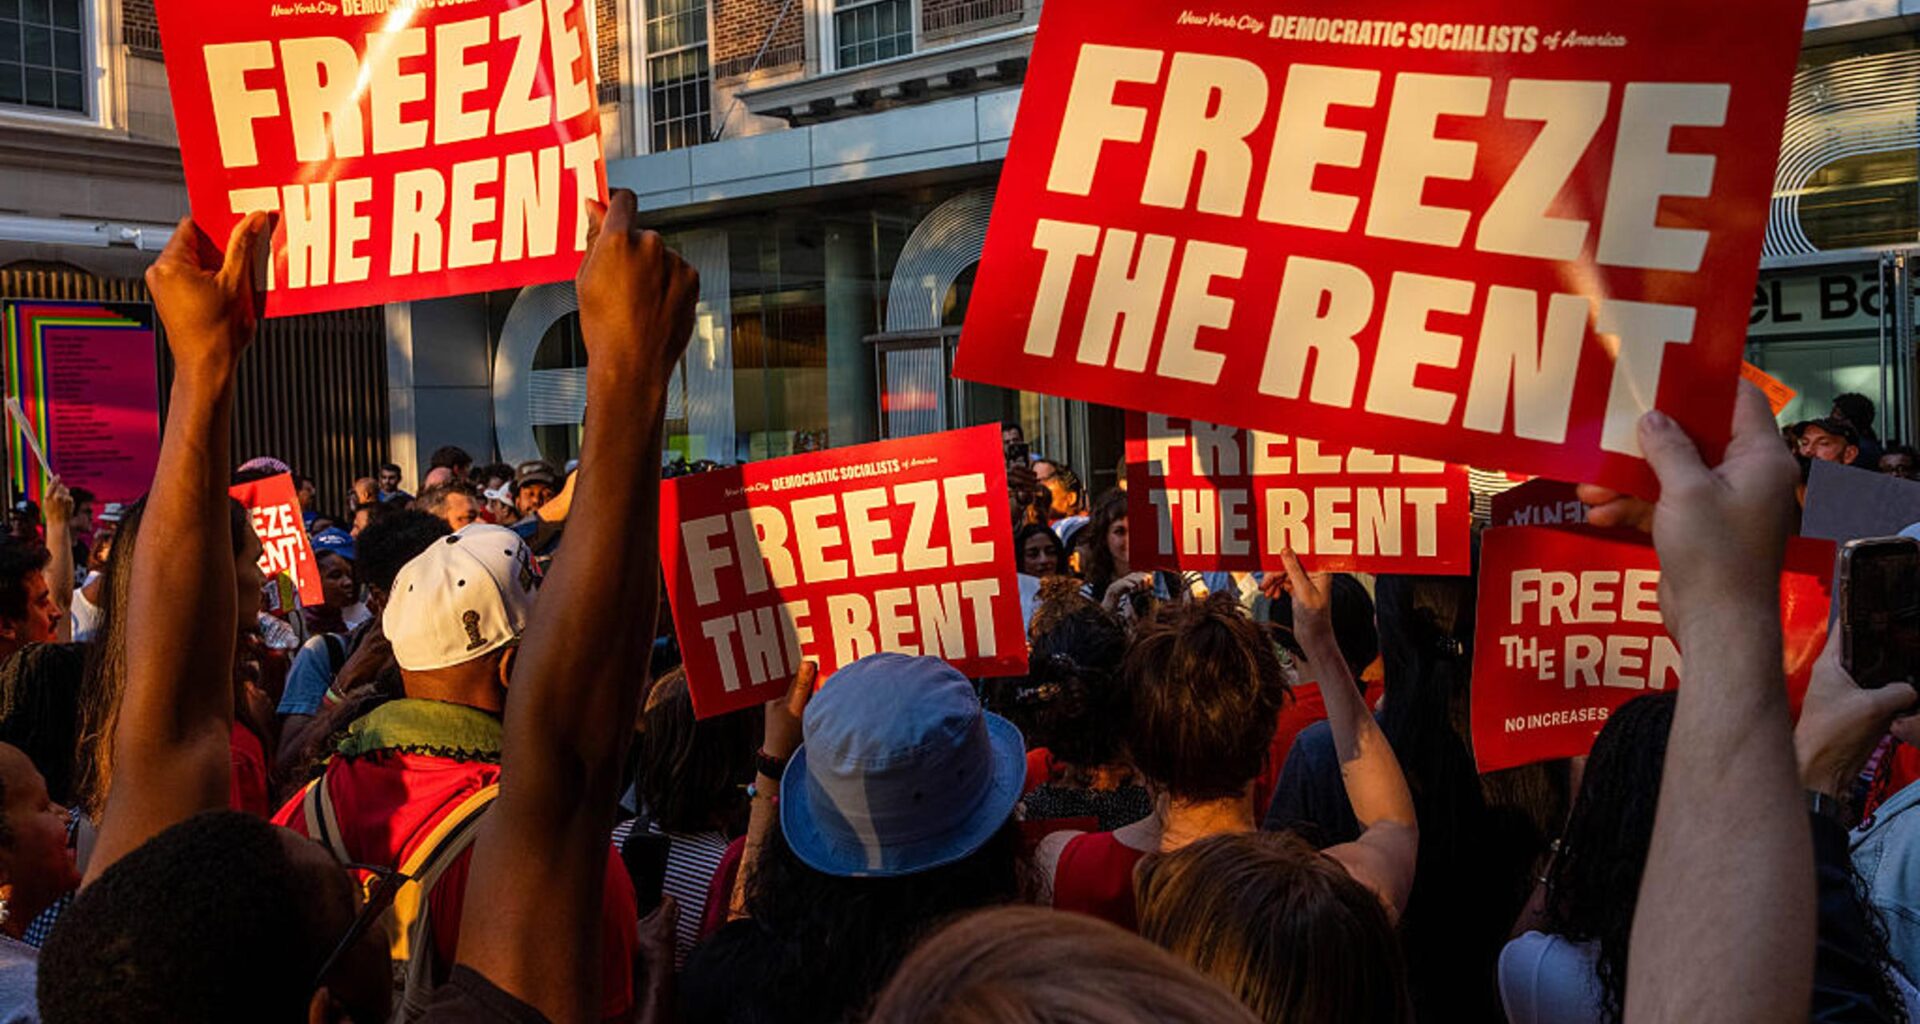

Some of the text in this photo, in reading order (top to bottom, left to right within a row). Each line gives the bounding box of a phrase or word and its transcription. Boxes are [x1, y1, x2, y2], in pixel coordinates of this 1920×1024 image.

[271, 4, 294, 16] New
[294, 2, 317, 15] York
[317, 1, 338, 15] City
[1177, 10, 1628, 53] New York City DEMOCRATIC SOCIALISTS of America
[203, 0, 591, 168] FREEZE
[1046, 43, 1732, 273] FREEZE
[228, 132, 600, 292] THE RENT
[1023, 218, 1697, 460] THE RENT
[772, 469, 839, 491] DEMOCRATIC
[840, 458, 900, 479] SOCIALISTS
[251, 503, 297, 538] EZE
[680, 472, 994, 608] FREEZE
[1149, 487, 1448, 558] THE RENT
[1511, 568, 1663, 626] FREE
[701, 578, 1000, 692] THE RENT
[1500, 634, 1682, 690] THE REN
[1505, 707, 1609, 733] NO INCREASES
